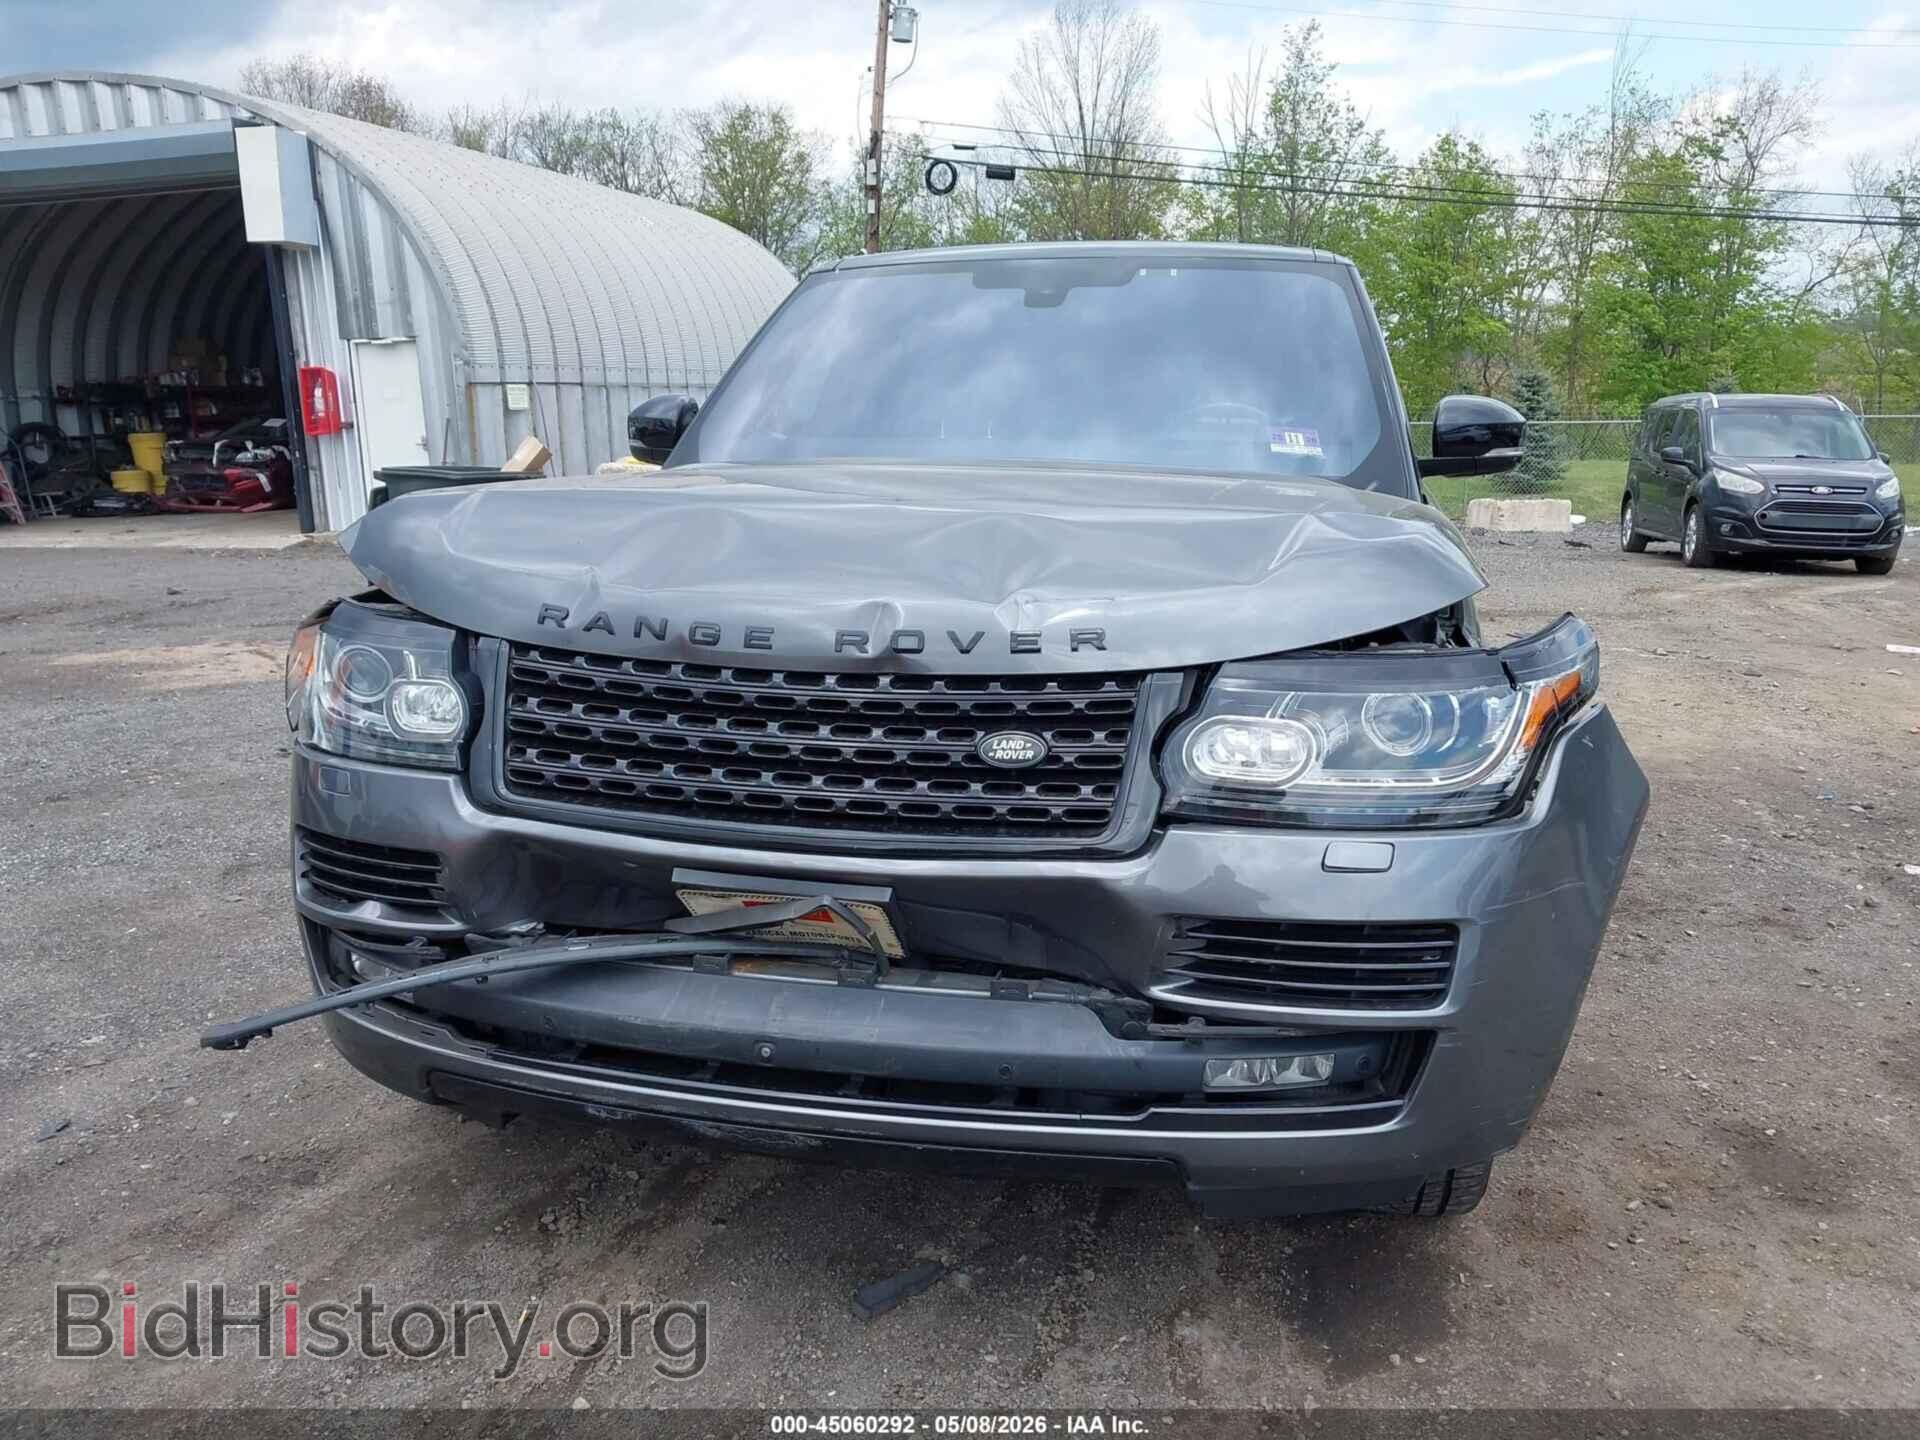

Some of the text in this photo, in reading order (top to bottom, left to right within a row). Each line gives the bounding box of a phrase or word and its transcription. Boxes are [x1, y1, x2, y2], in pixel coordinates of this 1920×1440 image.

[537, 602, 1108, 654] RANGE ROVER
[992, 739, 1025, 750] LAND
[994, 749, 1034, 760] ROVER
